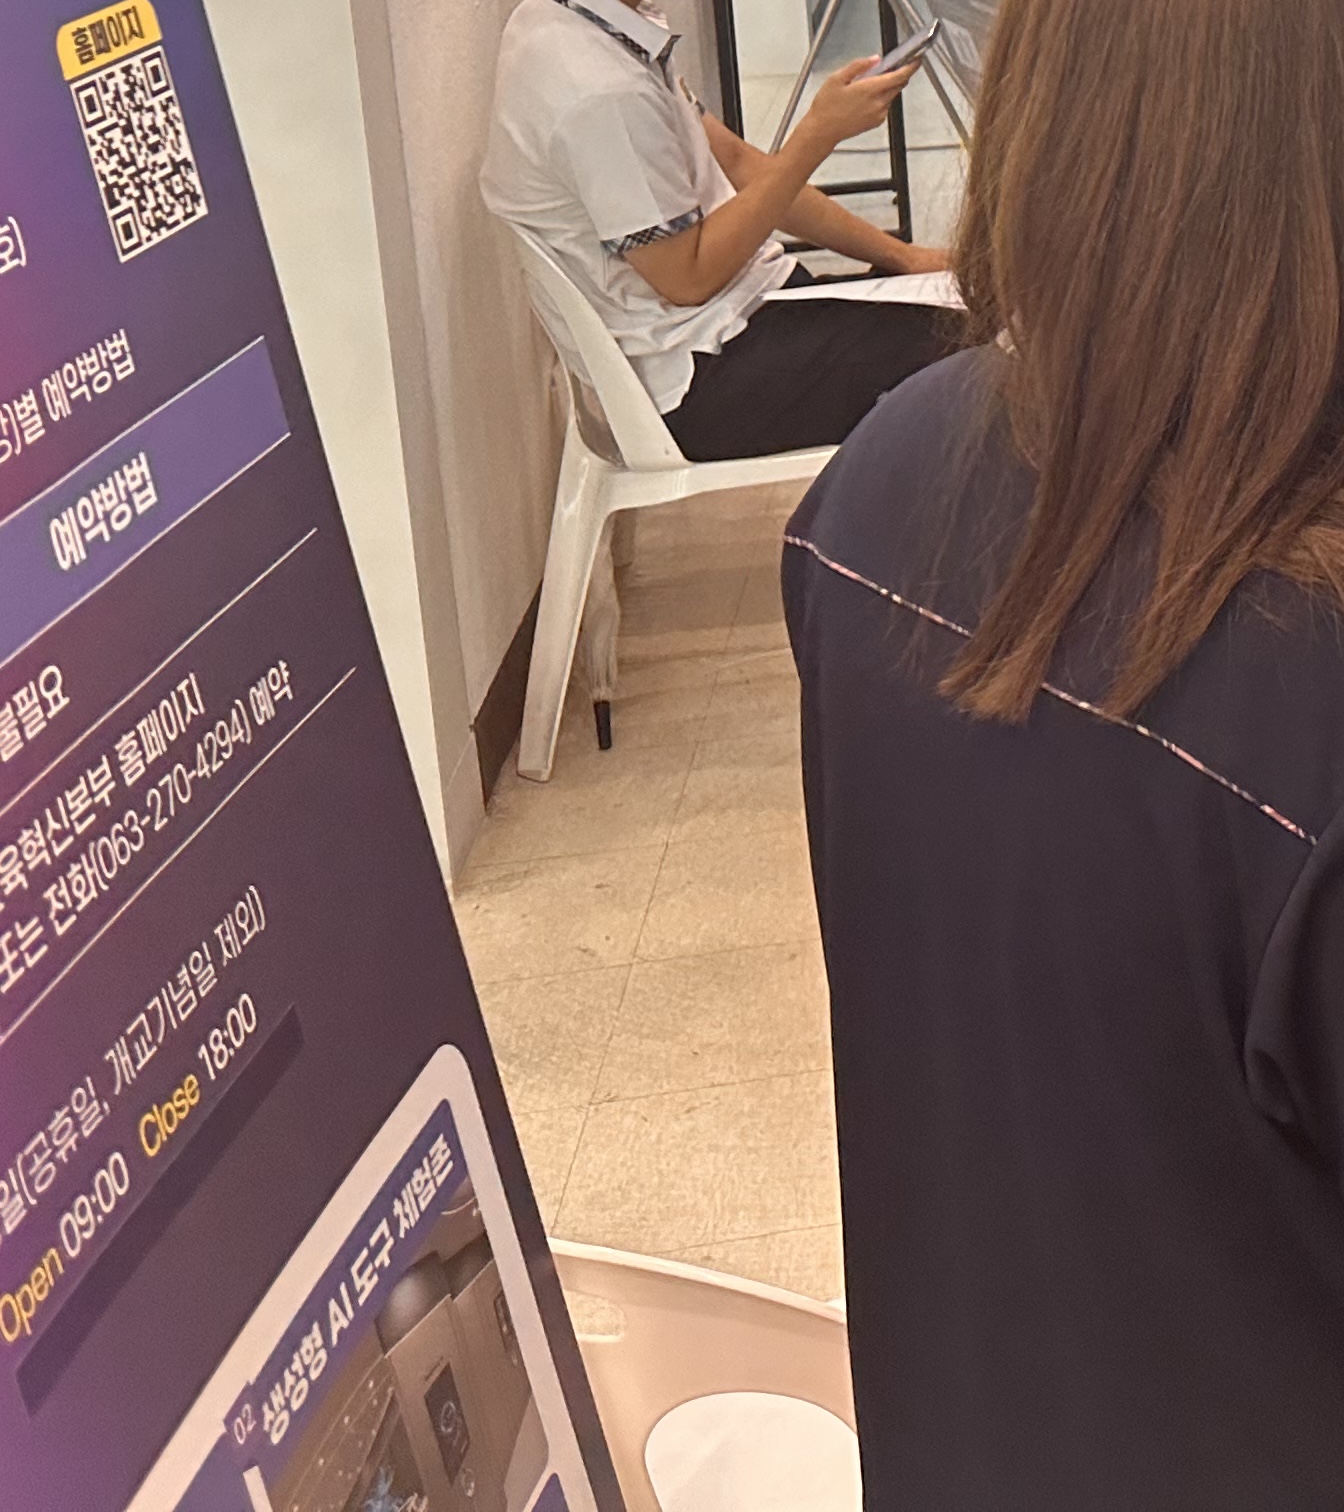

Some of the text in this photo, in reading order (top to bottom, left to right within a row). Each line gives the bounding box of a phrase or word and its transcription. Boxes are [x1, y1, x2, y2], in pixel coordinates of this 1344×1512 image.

[71, 5, 146, 65] 홈페이지
[41, 328, 136, 422] 예약방법
[49, 451, 159, 571] 예약방법
[43, 699, 254, 937] 전화(063-270-4294)
[249, 660, 293, 727] 예약
[115, 672, 205, 787] 홈페이지
[104, 941, 218, 1095] 개교기념일
[214, 885, 266, 967] 제외)
[0, 993, 257, 1343] Open 09:00 Close 18:00
[233, 1133, 454, 1446] 02 생성형 AI 도구 체험존
